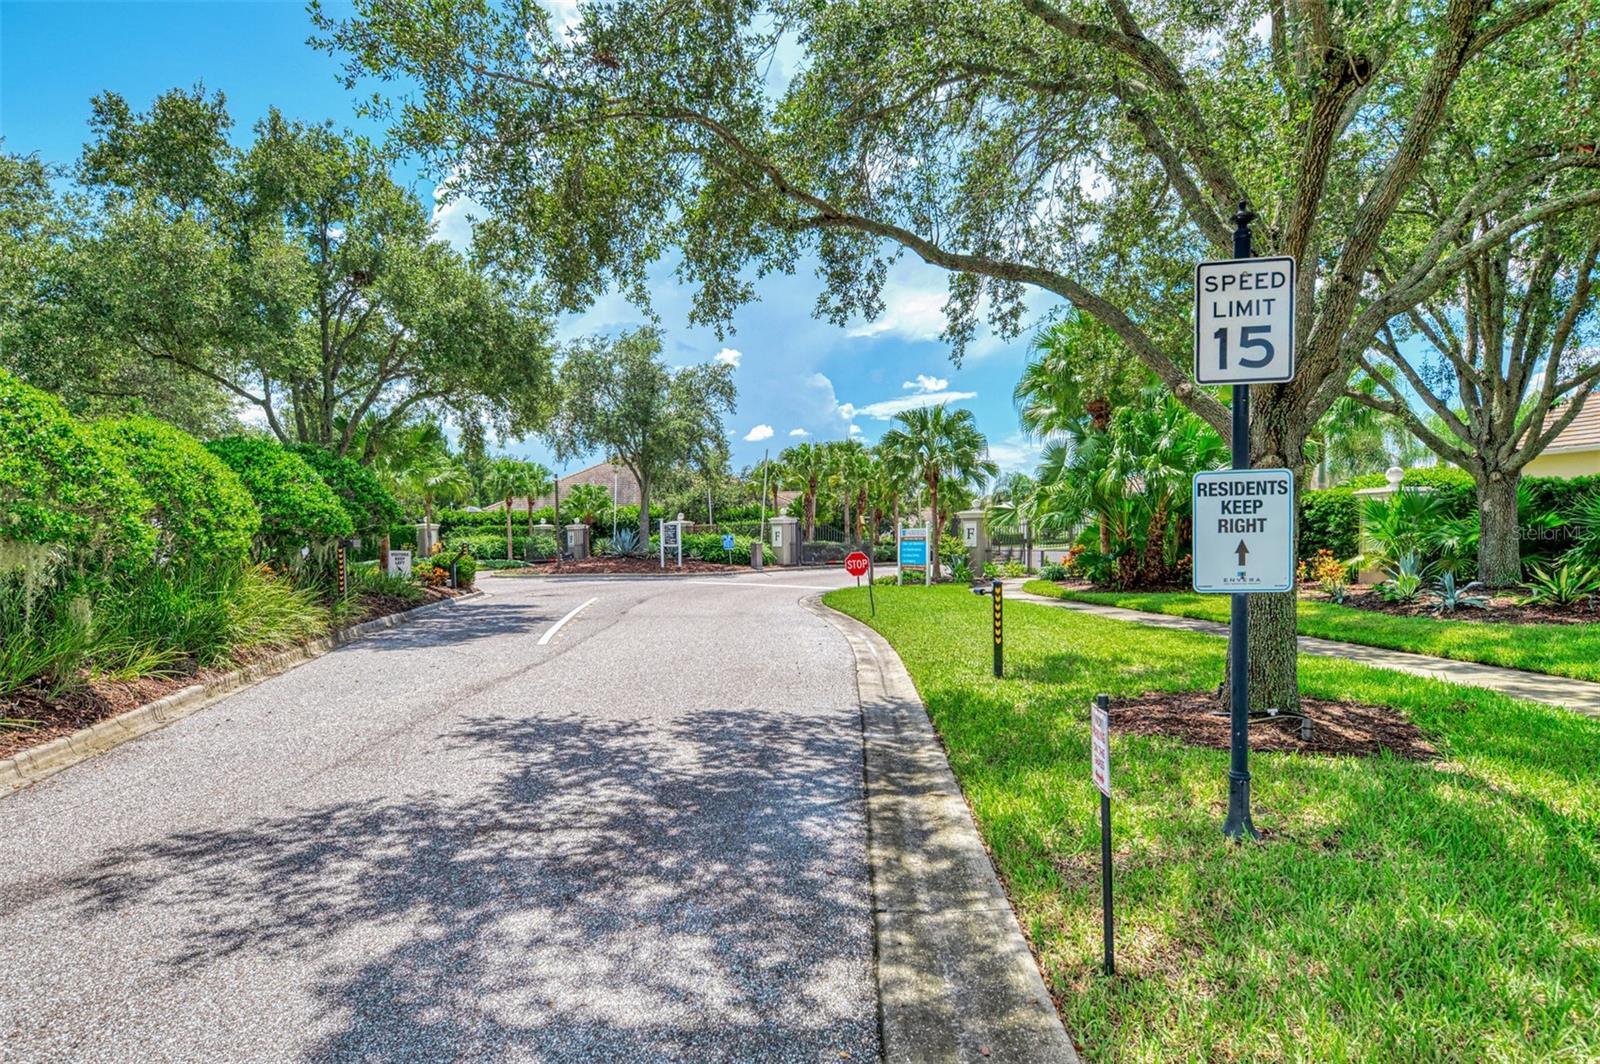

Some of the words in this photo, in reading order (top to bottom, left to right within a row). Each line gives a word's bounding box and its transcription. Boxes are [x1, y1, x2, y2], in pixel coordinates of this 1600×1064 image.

[1205, 272, 1286, 292] SPEED
[1213, 298, 1276, 318] LIMIT
[1214, 325, 1275, 370] 15
[1197, 480, 1288, 497] RESIDENTS
[1221, 500, 1263, 515] KEEP
[1217, 518, 1267, 533] RIGHT
[775, 531, 780, 541] F
[967, 528, 975, 539] F
[847, 559, 868, 570] STOP
